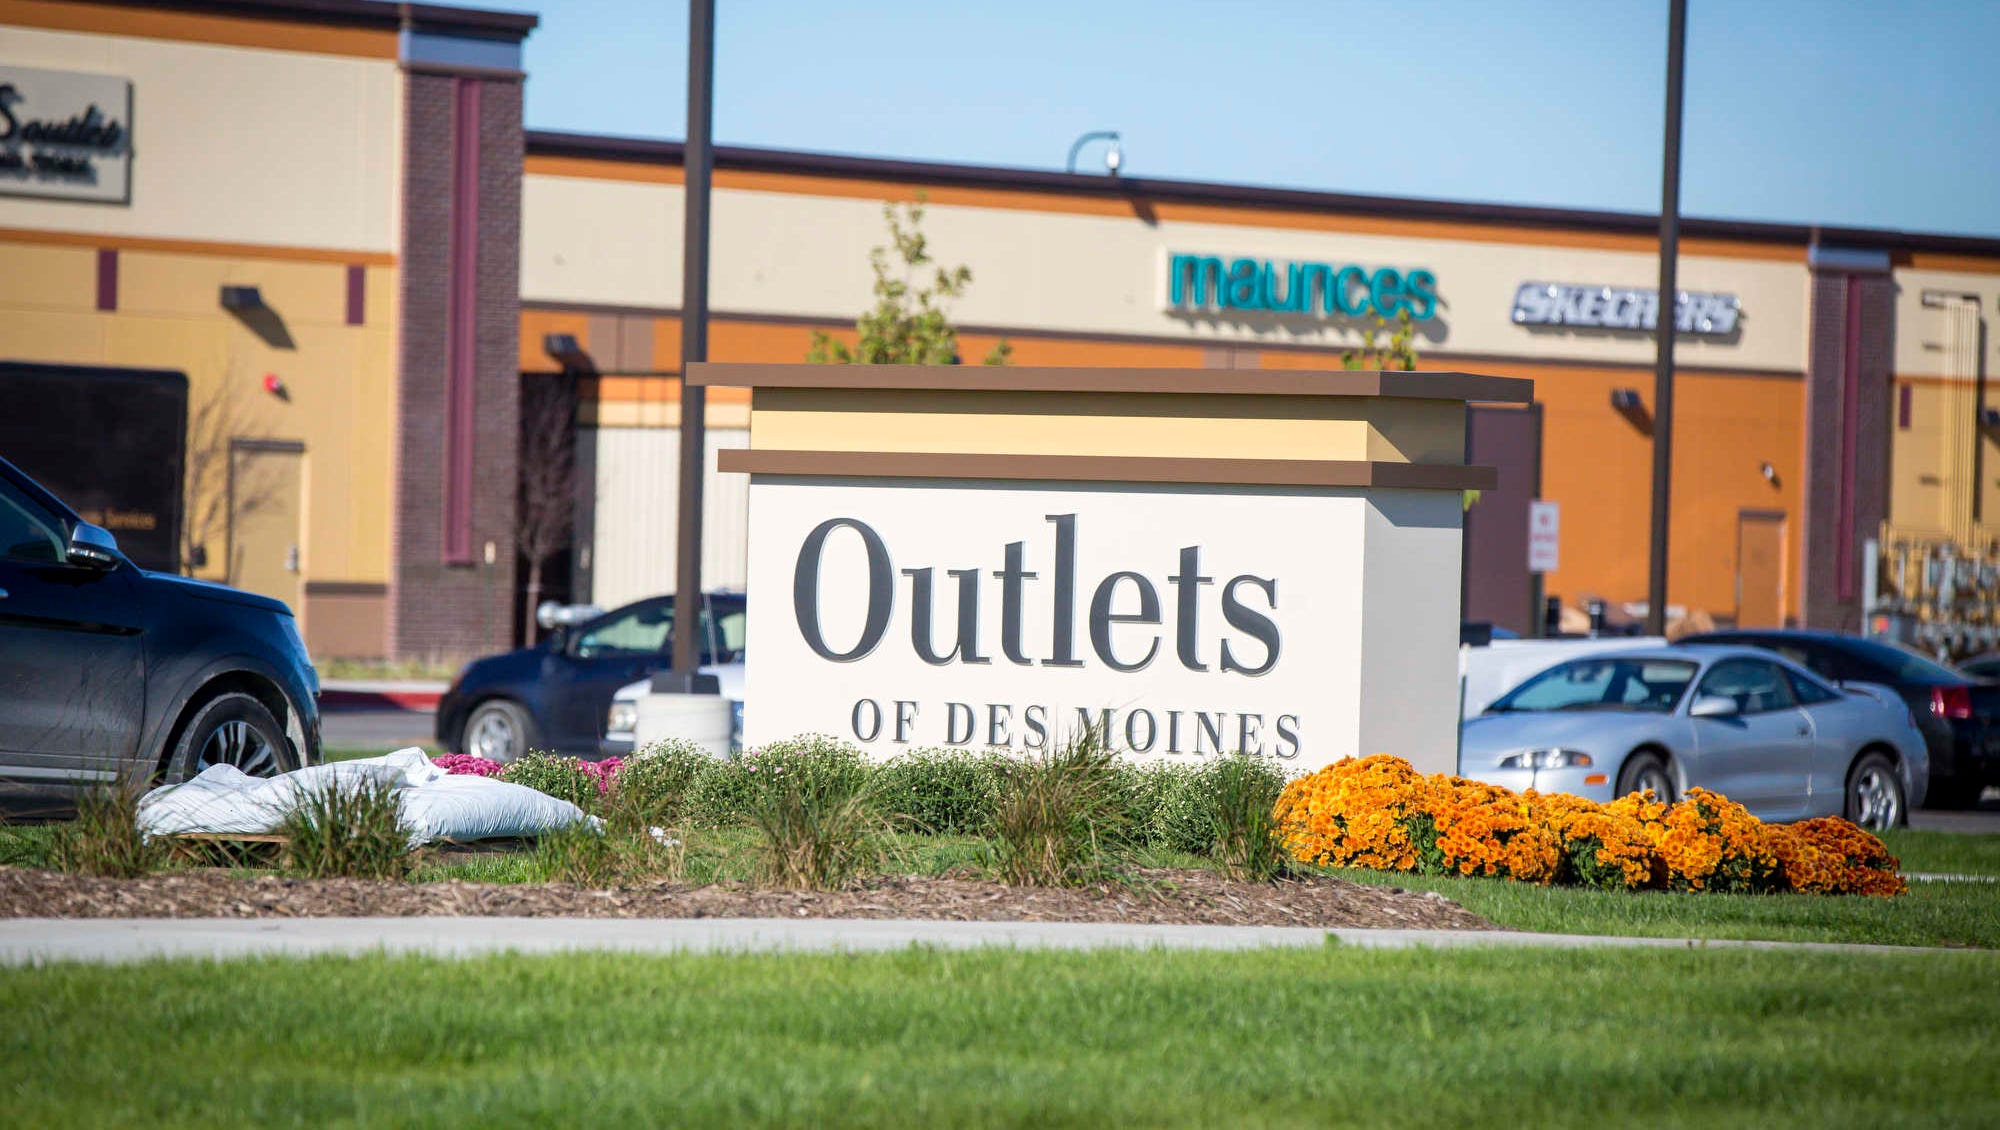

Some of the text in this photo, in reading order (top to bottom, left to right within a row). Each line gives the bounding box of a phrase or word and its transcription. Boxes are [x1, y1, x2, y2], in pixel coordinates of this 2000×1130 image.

[1513, 282, 1741, 334] SKECHRS
[793, 512, 1283, 677] Outlets
[850, 697, 1302, 760] OF DES MOINES
